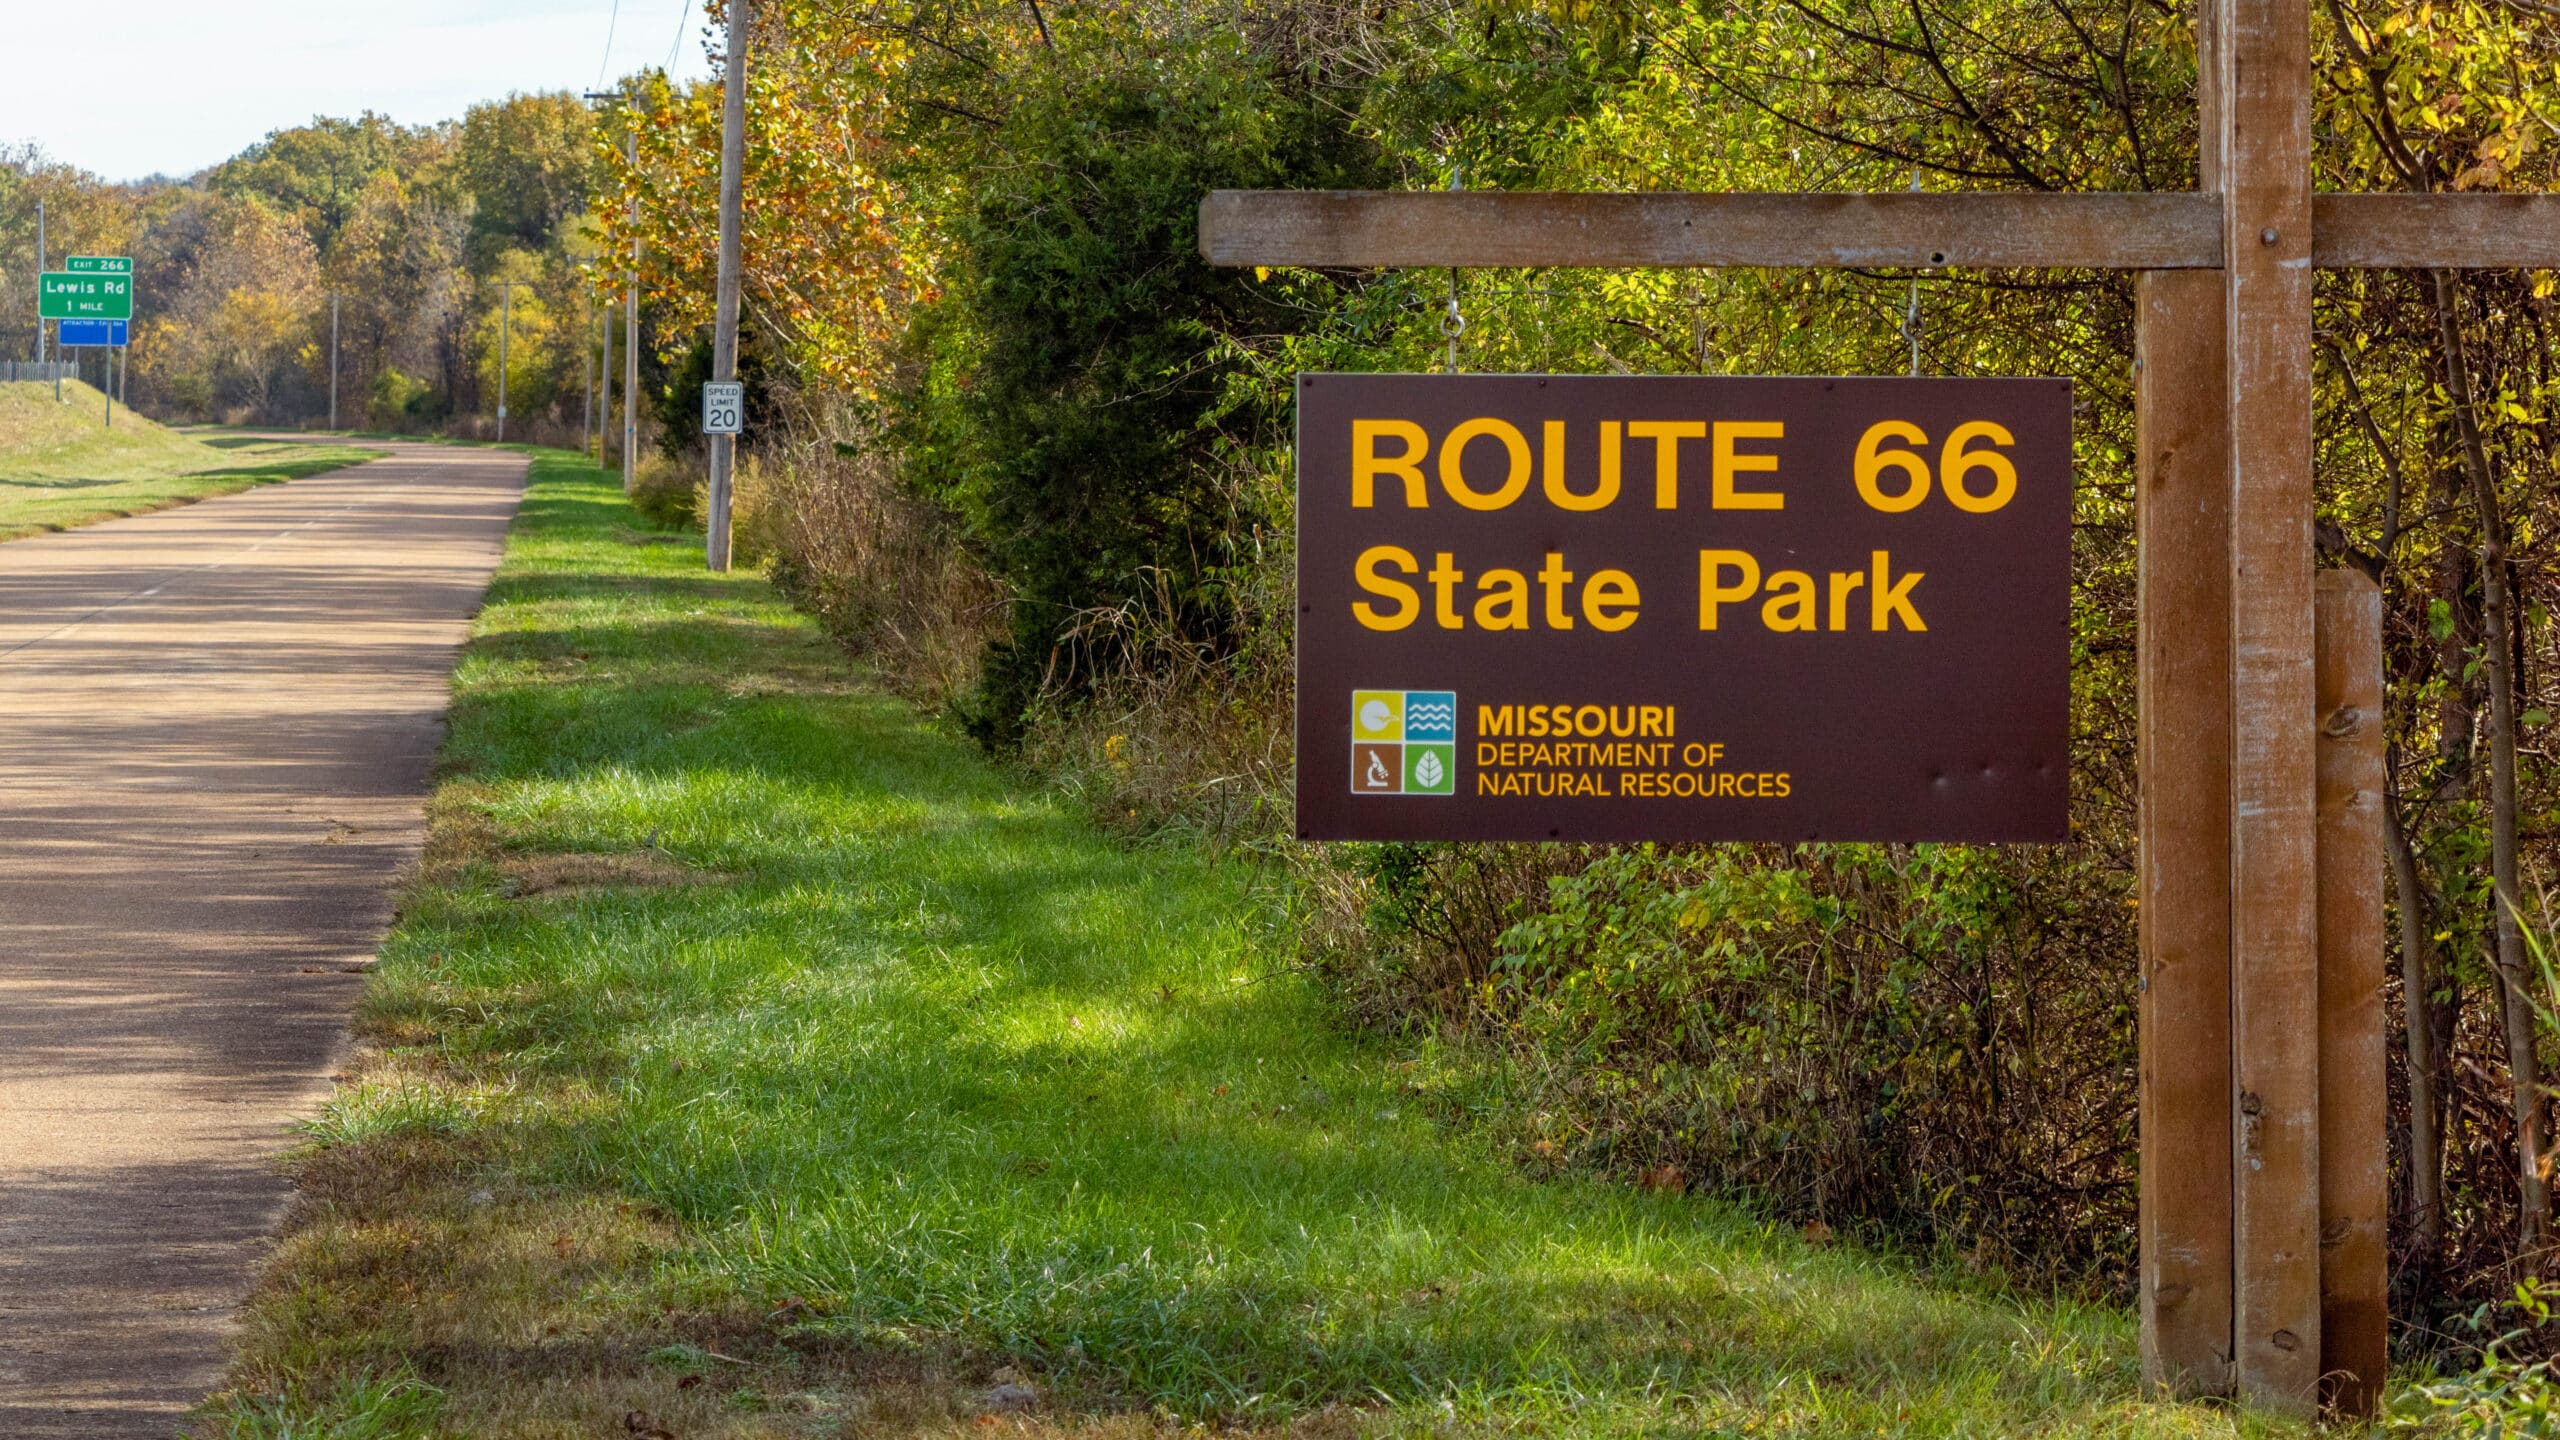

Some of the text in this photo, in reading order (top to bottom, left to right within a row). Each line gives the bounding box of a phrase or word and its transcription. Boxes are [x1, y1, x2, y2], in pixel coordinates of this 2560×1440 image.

[73, 259, 125, 270] EXIT 266
[46, 279, 125, 294] Lewis Rd
[67, 300, 104, 312] 1 MILE
[708, 387, 738, 396] SPEED
[711, 398, 734, 407] LIMIT
[710, 409, 736, 427] 20
[1350, 417, 2019, 514] ROUTE 66
[1350, 544, 1929, 634] State Park
[1477, 703, 1676, 738] MISSOURI
[1477, 741, 1725, 768] DEPARTMENT OF
[1477, 771, 1792, 799] NATURAL RESOURCES
